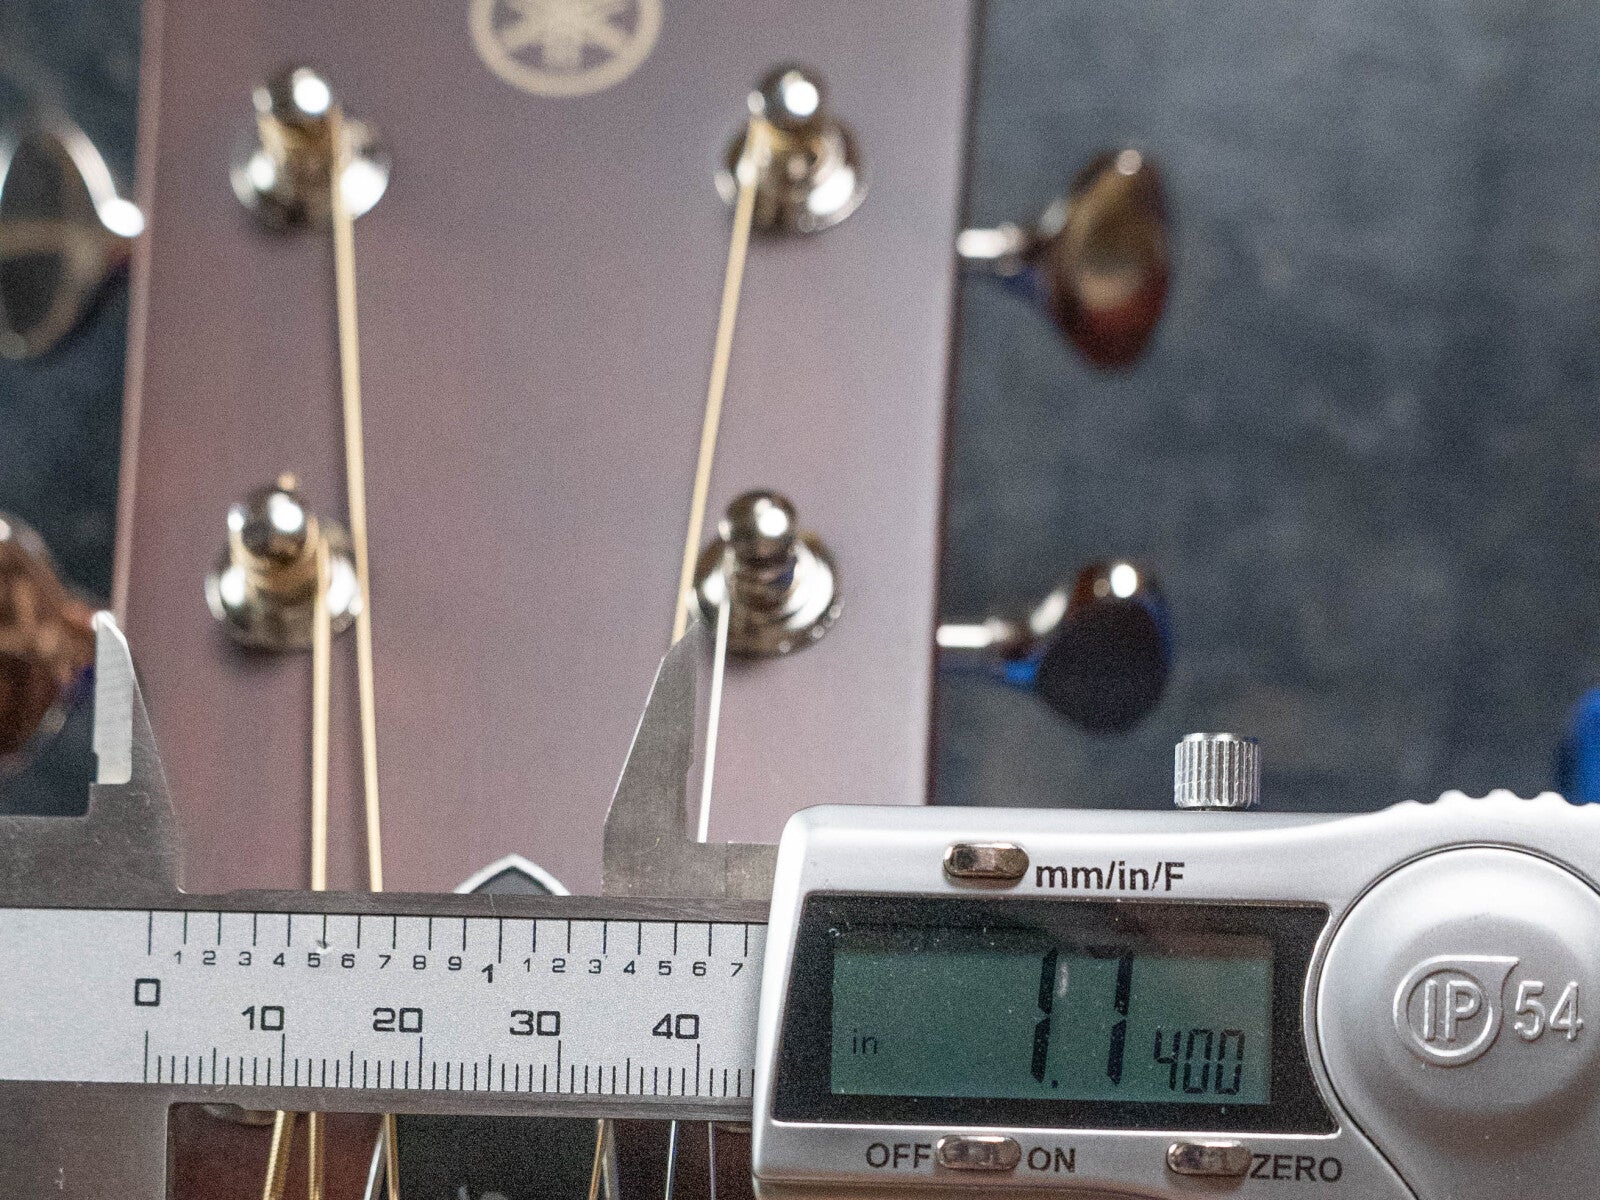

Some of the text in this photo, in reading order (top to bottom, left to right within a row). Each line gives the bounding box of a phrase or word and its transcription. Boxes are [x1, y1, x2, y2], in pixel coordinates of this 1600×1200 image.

[1036, 860, 1185, 892] mm/in/F
[174, 950, 744, 984] 1 2 3 4 5 6 7 8 9 1 1 2 3 4 5 6 7
[134, 977, 700, 1040] 0 10 20 30 40
[1423, 979, 1584, 1043] IP 54
[850, 1028, 879, 1056] in
[865, 1142, 931, 1169] OFF
[1027, 1146, 1077, 1173] ON
[1250, 1152, 1344, 1183] ZERO
